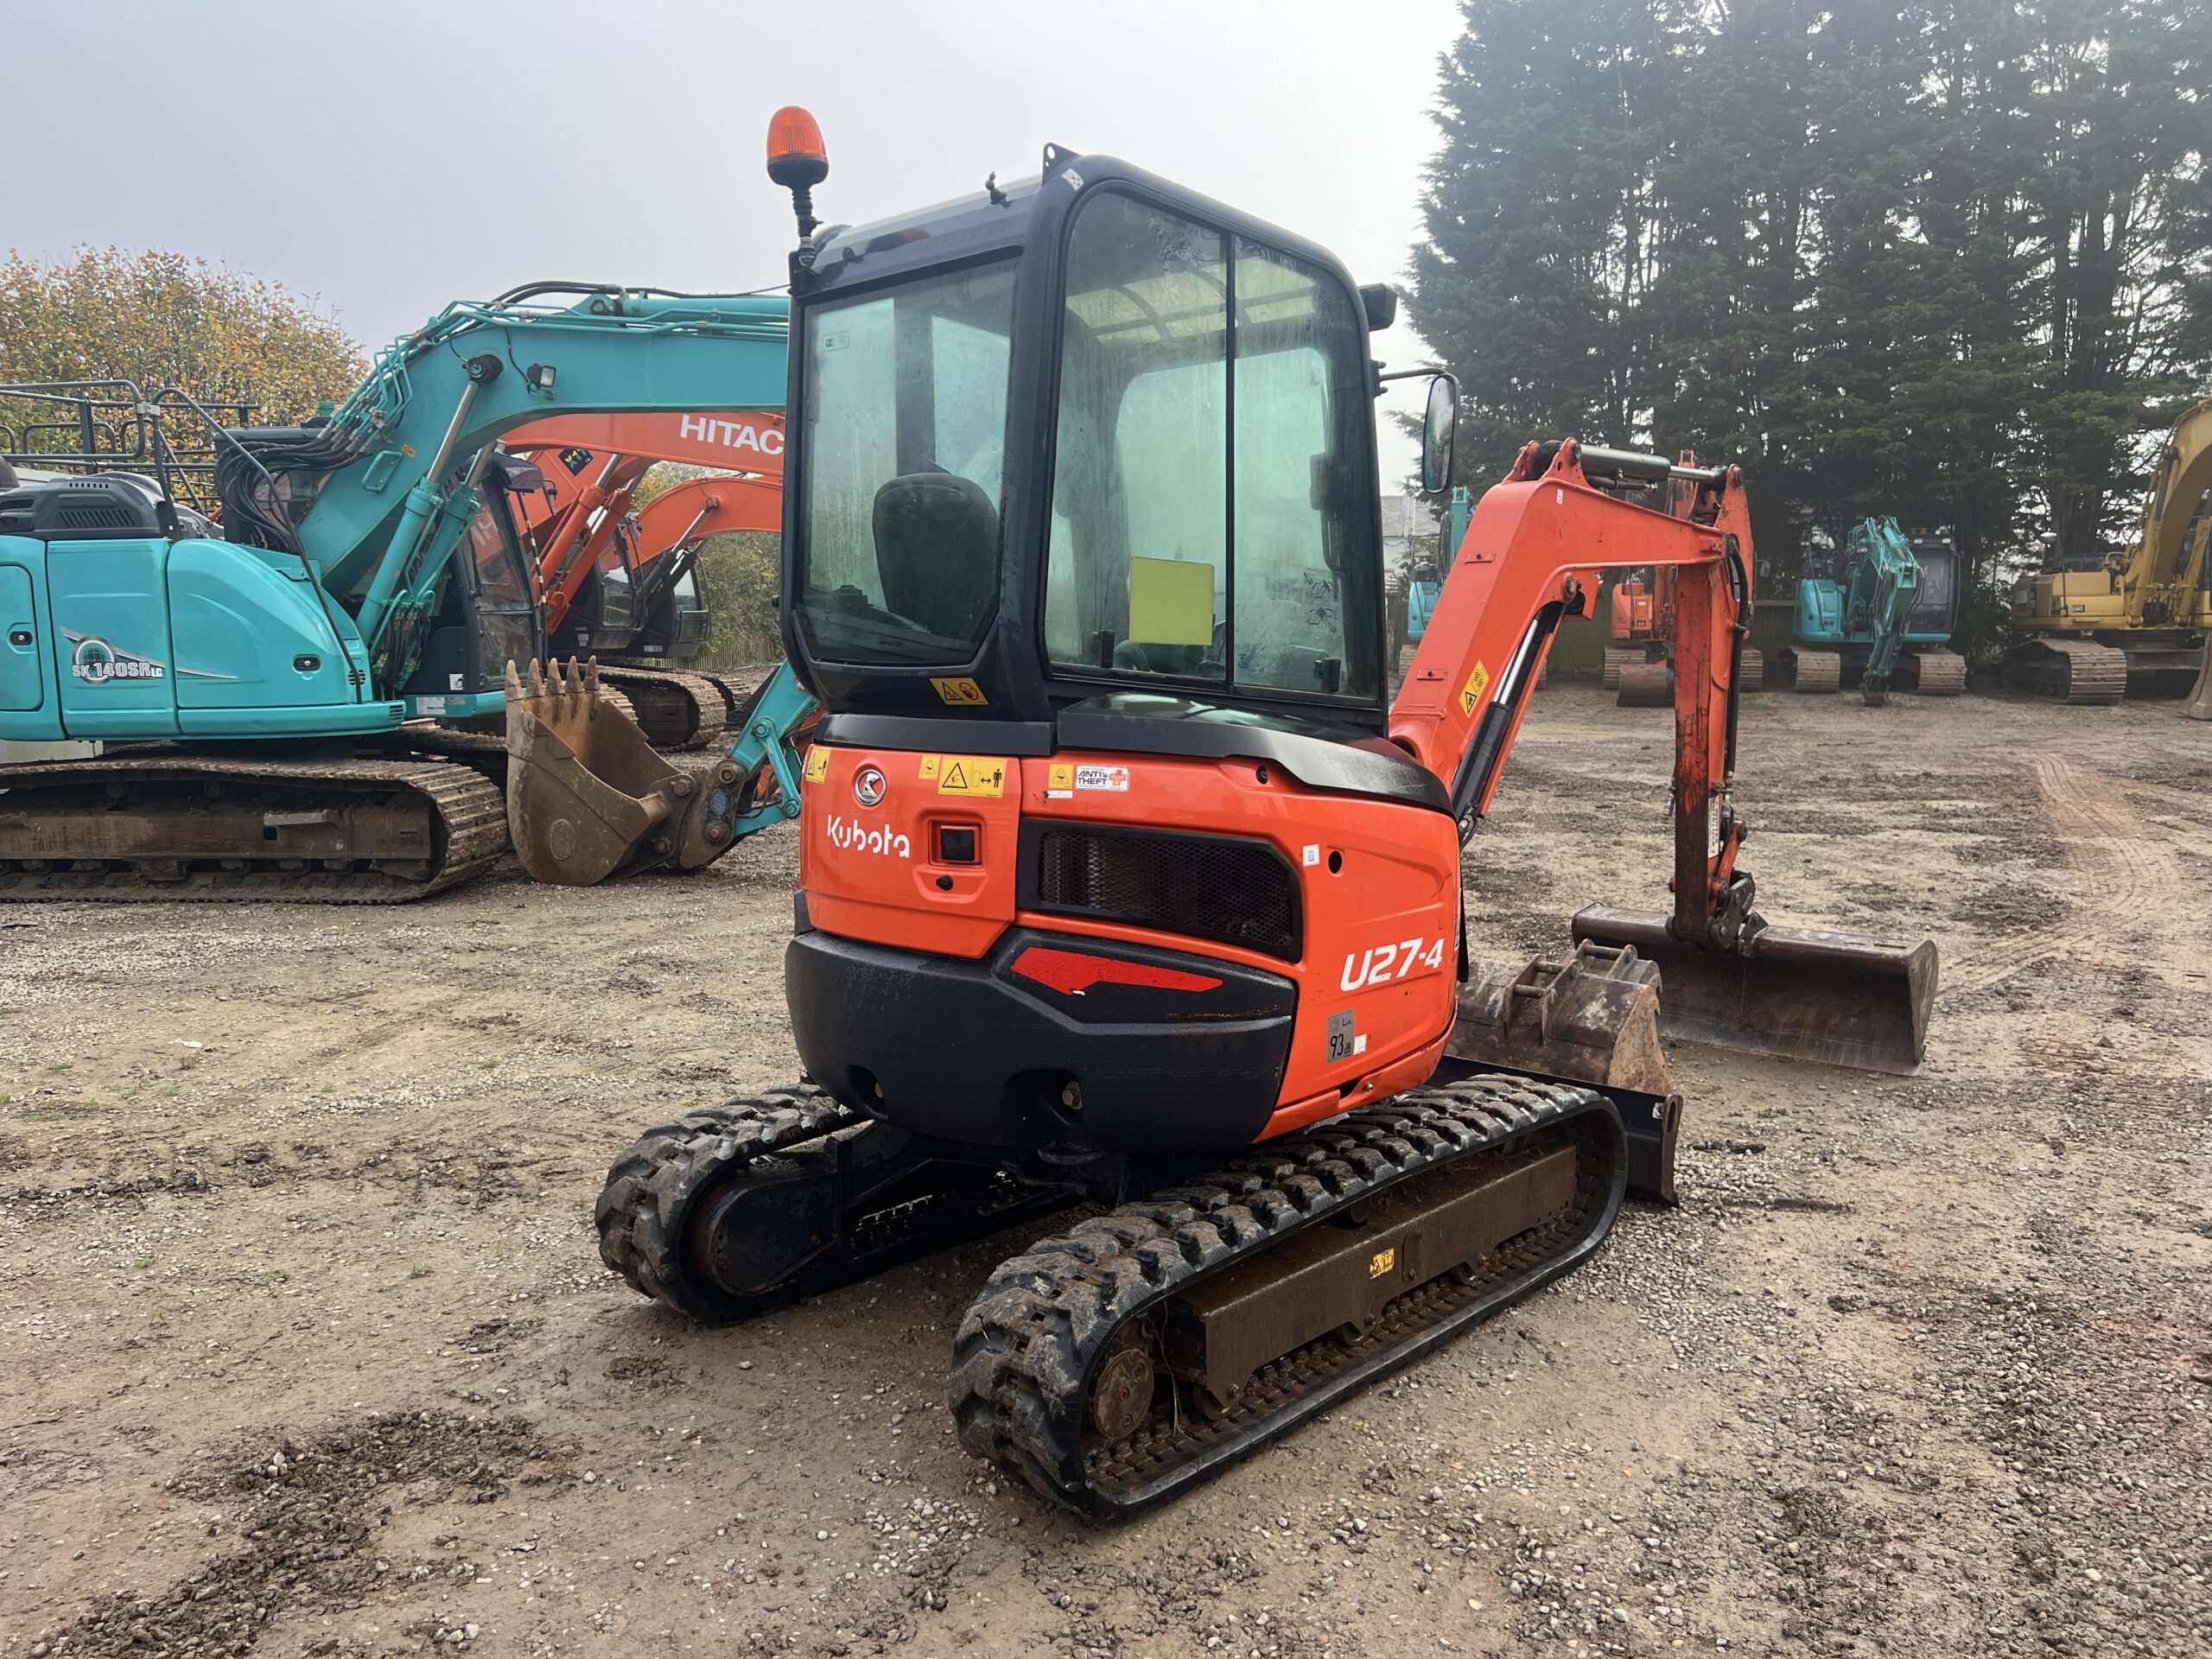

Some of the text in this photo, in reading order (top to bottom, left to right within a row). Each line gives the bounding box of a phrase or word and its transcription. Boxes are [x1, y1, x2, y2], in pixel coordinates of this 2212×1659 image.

[679, 414, 785, 455] HITAC
[72, 664, 91, 678] SK
[827, 814, 911, 858] Kubota
[1340, 937, 1445, 992] U27-4
[1330, 1033, 1344, 1058] 93
